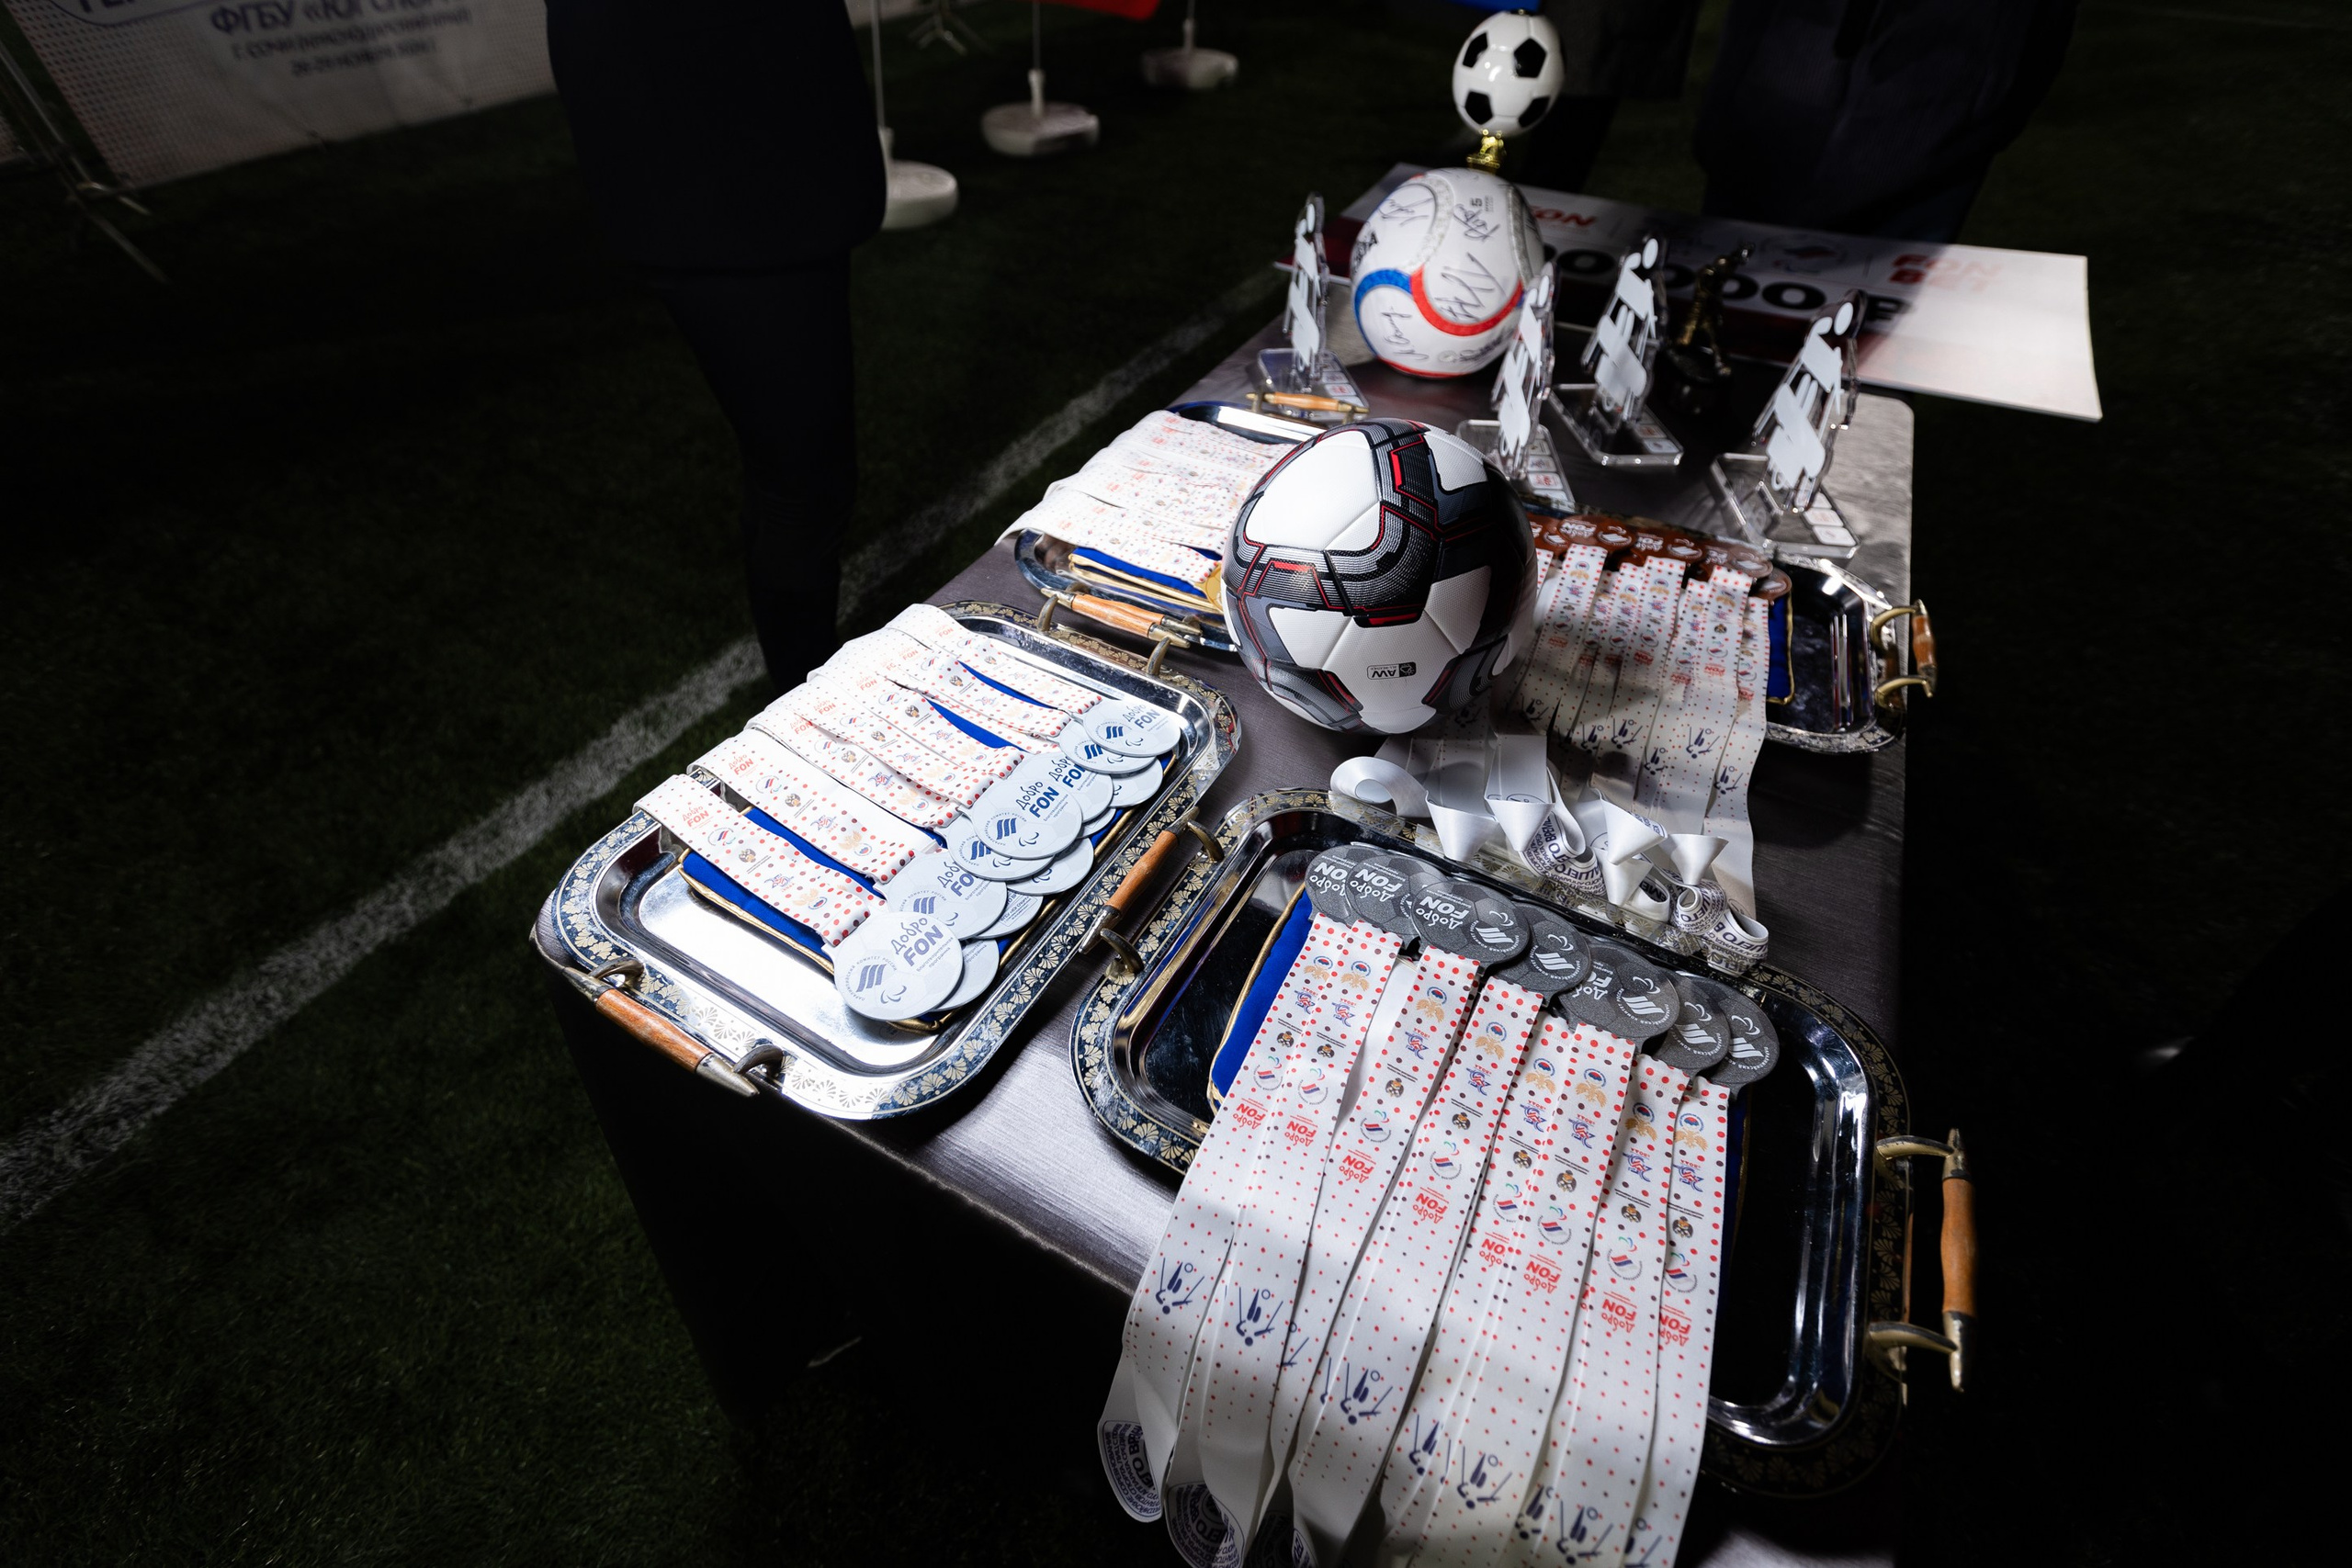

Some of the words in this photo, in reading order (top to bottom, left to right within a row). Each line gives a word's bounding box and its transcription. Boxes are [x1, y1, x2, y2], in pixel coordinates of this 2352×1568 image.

[1530, 206, 1597, 225] ON
[1560, 522, 1597, 531] FON
[1373, 670, 1396, 678] AW
[1135, 709, 1160, 728] FON
[1049, 756, 1071, 782] Добр
[1016, 782, 1044, 810] Добро
[1029, 786, 1060, 818] FON
[937, 862, 960, 888] Доб
[1314, 862, 1348, 882] ON
[1355, 869, 1402, 892] FON
[950, 874, 974, 897] FO
[1350, 880, 1395, 902] Добро
[1415, 908, 1463, 930] Добро
[1419, 897, 1469, 919] FON
[890, 918, 928, 954] Добро
[903, 925, 944, 966] FON
[856, 956, 880, 964] КОМИТЕТ
[882, 958, 898, 971] РОССИИ
[1233, 1113, 1261, 1130] Добро
[1237, 1103, 1266, 1121] FON
[1284, 1132, 1314, 1147] Добро
[1286, 1121, 1317, 1137] FON
[1340, 1166, 1369, 1183] Добро
[1342, 1156, 1374, 1174] FON
[1413, 1204, 1443, 1224] Добро
[1416, 1192, 1448, 1214] FON
[1481, 1238, 1505, 1256] ON
[1479, 1251, 1502, 1268] обро
[1523, 1273, 1557, 1293] Добро
[1526, 1261, 1560, 1283] FON
[1602, 1299, 1636, 1321] FON
[1601, 1312, 1635, 1334] Добро
[1120, 1463, 1136, 1495] СПОРТА
[1126, 1461, 1148, 1494] АППАРАТА
